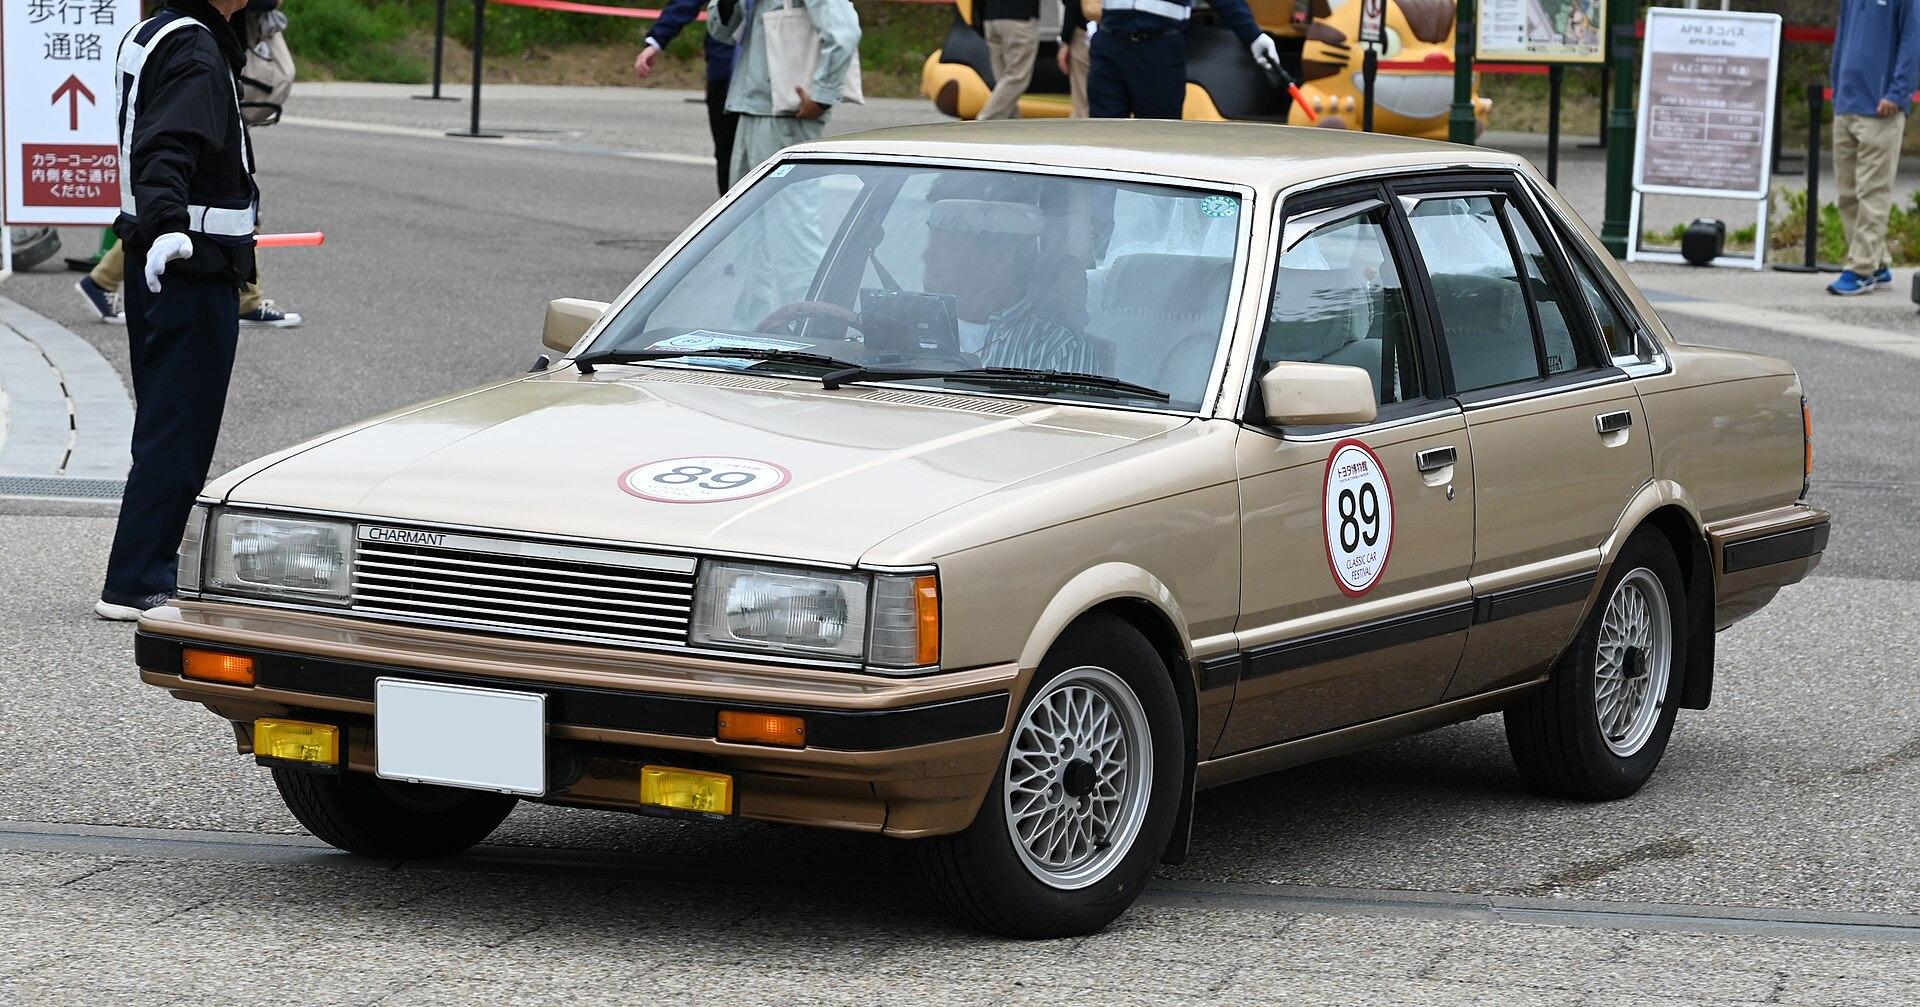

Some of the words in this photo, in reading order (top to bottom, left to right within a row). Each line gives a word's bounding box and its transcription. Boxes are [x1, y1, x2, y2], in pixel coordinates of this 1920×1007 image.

[28, 0, 116, 24] 歩行者
[44, 32, 102, 60] 通路
[32, 153, 117, 168] カラーコーンの
[32, 168, 117, 184] 内側をご通行
[50, 183, 101, 198] ください
[653, 466, 757, 490] 89
[1338, 482, 1380, 554] 89
[369, 527, 447, 546] CHARMANT
[1346, 554, 1366, 570] CLASSIC
[1366, 551, 1377, 564] CAR
[1351, 566, 1372, 581] FESTIVAL
